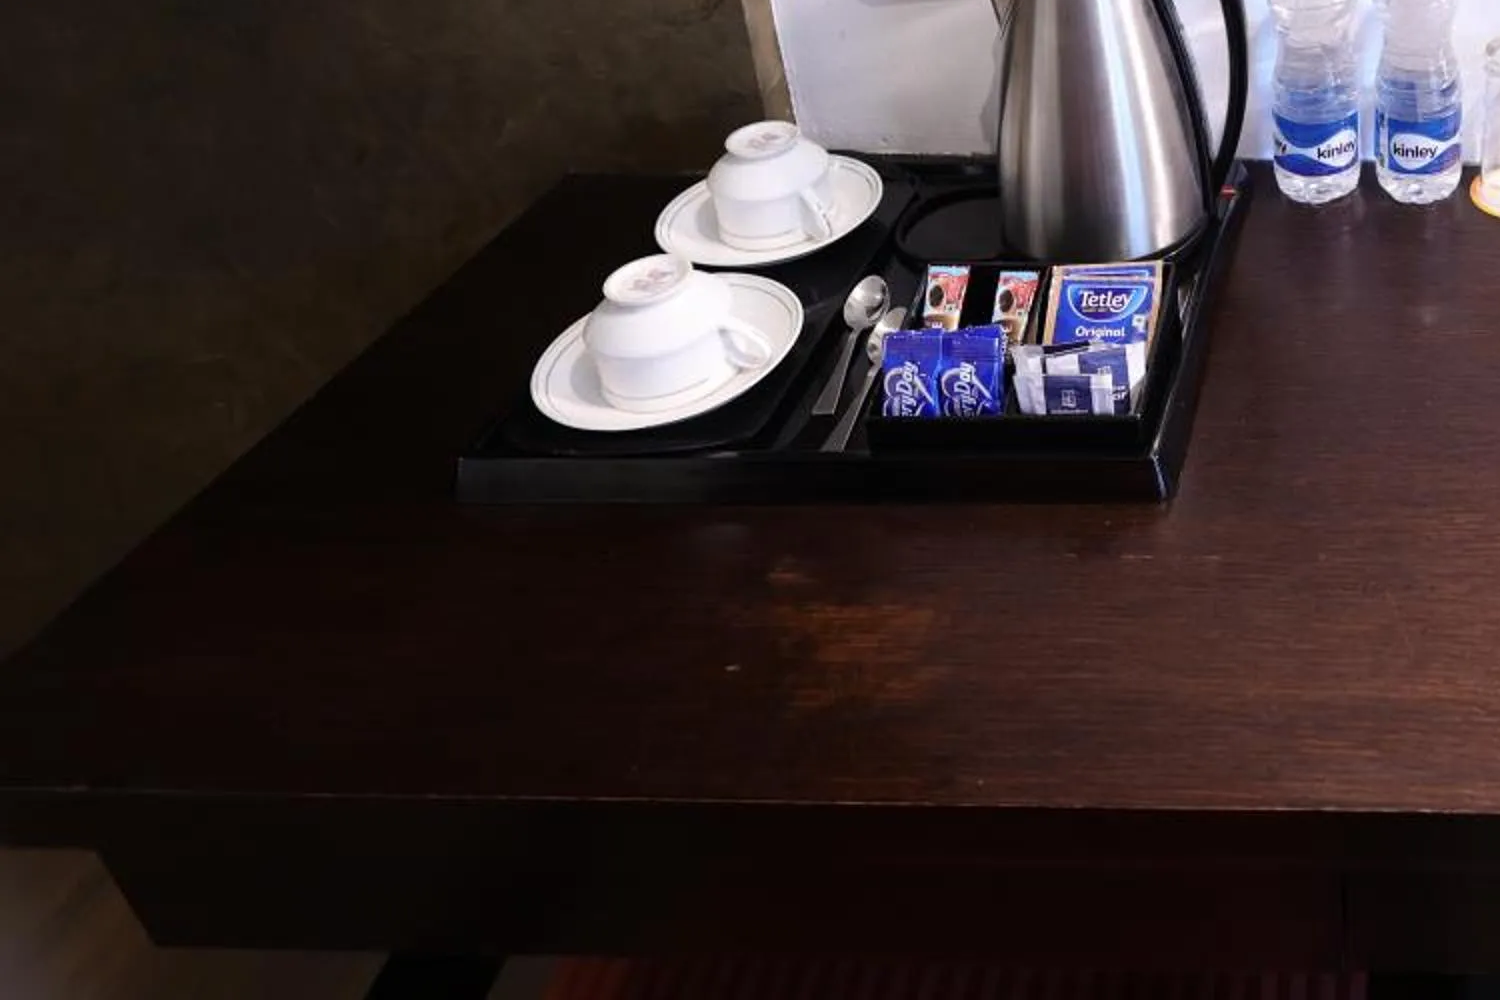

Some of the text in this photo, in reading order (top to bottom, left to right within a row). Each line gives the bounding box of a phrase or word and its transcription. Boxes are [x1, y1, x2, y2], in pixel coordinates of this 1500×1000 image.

[1317, 141, 1356, 160] kinley
[1393, 142, 1438, 159] kinley
[1079, 289, 1133, 313] Tetley
[1075, 325, 1126, 341] Original
